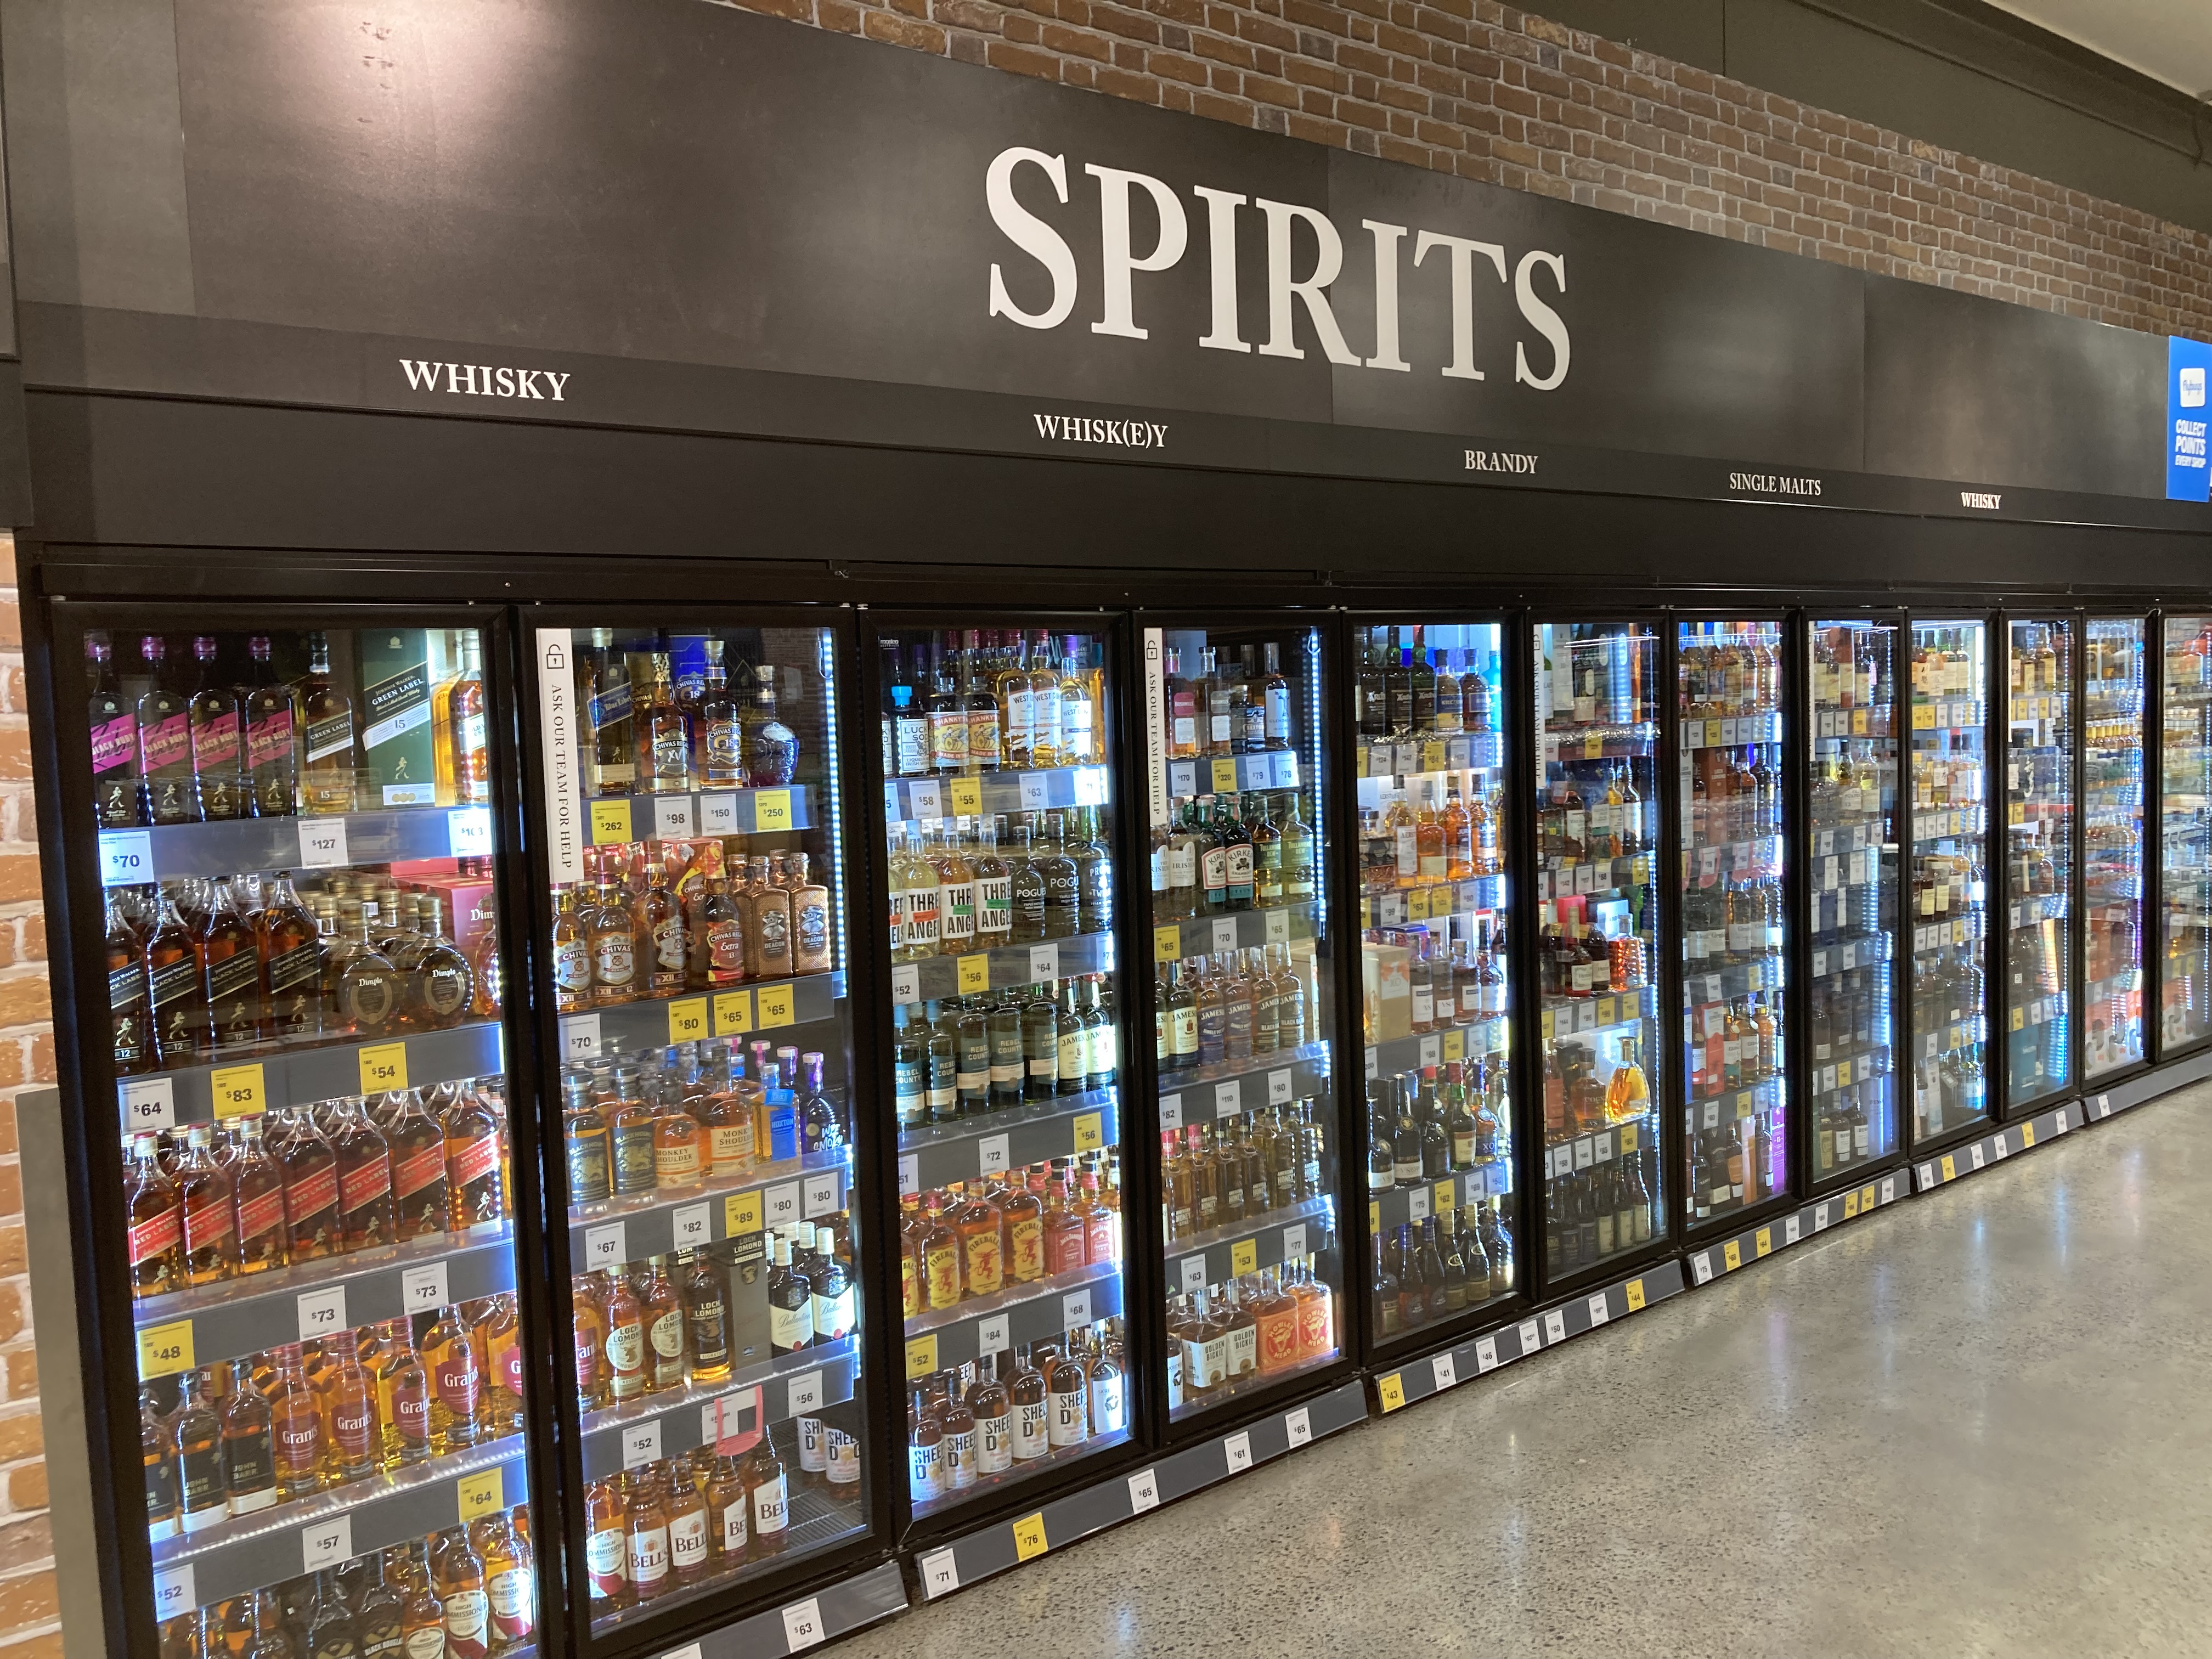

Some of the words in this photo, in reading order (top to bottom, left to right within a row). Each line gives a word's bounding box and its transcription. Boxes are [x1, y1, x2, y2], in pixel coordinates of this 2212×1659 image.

[985, 145, 1572, 391] SPIRITS
[400, 359, 570, 401] WHISKY
[1034, 414, 1168, 449] WHISK(E)Y
[2176, 419, 2207, 437] COLLECT
[2175, 436, 2206, 455] POINTS
[1464, 449, 1538, 474] BRANDY
[1729, 472, 1778, 493] SINGLE
[1780, 476, 1821, 496] MALTS
[1961, 492, 2001, 510] WHISKY
[375, 682, 395, 696] JOHNNIE
[676, 679, 696, 689] CHIVAS
[372, 689, 398, 706] GREEN
[399, 679, 424, 694] LABEL
[552, 685, 563, 712] ASK
[605, 700, 617, 709] Blue
[618, 695, 631, 706] Label
[1013, 696, 1028, 704] WEST
[394, 719, 406, 729] 15
[310, 727, 331, 741] GREEN
[332, 721, 351, 732] LABEL
[554, 716, 565, 746] OUR
[710, 728, 731, 738] CHIVAS
[92, 741, 112, 755] BLACK
[250, 737, 271, 750] BLACK
[654, 741, 676, 749] CHIVAS
[668, 750, 681, 761] XV
[556, 751, 567, 794] TEAM
[1028, 788, 1041, 797] $63
[919, 796, 934, 805] $58
[960, 795, 974, 805] $55
[558, 798, 569, 825] FOR
[712, 809, 729, 817] $150
[667, 814, 685, 823] $98
[601, 822, 622, 831] $262
[312, 839, 336, 849] $127
[561, 830, 572, 868] HELP
[112, 854, 140, 868] $70
[982, 882, 1011, 900] THREE
[1017, 888, 1046, 897] POGUES
[909, 891, 939, 907] THREE
[710, 933, 729, 941] CHIVAS
[601, 945, 631, 955] CHIVAS
[721, 942, 738, 950] Extra
[764, 940, 785, 949] DEACON
[274, 964, 295, 975] BLACK
[295, 952, 317, 966] LABEL
[1037, 963, 1050, 972] $64
[212, 973, 234, 983] BLACK
[235, 960, 256, 972] LABEL
[432, 968, 456, 978] Dimple
[966, 972, 981, 982] $56
[359, 977, 382, 987] Dimple
[662, 973, 674, 983] XII
[895, 986, 910, 995] $52
[562, 993, 574, 1002] XII
[768, 1005, 785, 1015] $65
[724, 1011, 742, 1022] $65
[679, 1018, 698, 1029] $80
[173, 1042, 183, 1051] 12
[571, 1037, 591, 1048] $70
[371, 1065, 395, 1079] $54
[896, 1075, 921, 1084] COUNTY
[226, 1088, 252, 1102] $83
[133, 1102, 161, 1116] $64
[771, 1118, 793, 1128] HOXTON
[1082, 1131, 1095, 1139] $56
[813, 1134, 843, 1151] SMOKY
[657, 1147, 688, 1156] MONKEY
[988, 1152, 1000, 1160] $72
[656, 1154, 693, 1163] SHOULDER
[346, 1183, 362, 1194] RED
[363, 1167, 388, 1184] LABEL
[292, 1195, 307, 1206] RED
[309, 1178, 336, 1195] LABEL
[813, 1190, 831, 1201] $80
[774, 1200, 791, 1211] $80
[735, 1211, 753, 1223] $89
[684, 1221, 702, 1232] $82
[597, 1240, 616, 1252] $67
[969, 1235, 1000, 1251] FIREBALL
[416, 1286, 437, 1298] $73
[1631, 1293, 1640, 1301] $44
[701, 1300, 720, 1310] LOCH
[1070, 1305, 1083, 1314] $68
[312, 1309, 335, 1323] $73
[695, 1306, 725, 1316] LOMOND
[620, 1325, 638, 1335] LOCH
[1268, 1321, 1294, 1338] HOWLER
[1551, 1325, 1560, 1333] $50
[613, 1331, 642, 1342] LOMOND
[986, 1330, 1000, 1340] $84
[1234, 1329, 1255, 1342] GOLDEN
[1235, 1338, 1254, 1349] BICKIE
[153, 1346, 180, 1359] $48
[700, 1350, 726, 1359] SIGNATURE
[1274, 1348, 1291, 1358] HEAD
[1482, 1352, 1492, 1361] $46
[913, 1356, 929, 1365] $52
[1440, 1369, 1450, 1378] $41
[797, 1392, 812, 1403] $56
[1386, 1391, 1398, 1400] $43
[337, 1414, 372, 1430] Grant's
[1294, 1425, 1306, 1434] $65
[283, 1427, 319, 1444] Grant's
[633, 1438, 652, 1449] $52
[1234, 1449, 1245, 1458] $61
[233, 1462, 257, 1472] JOHN
[233, 1470, 257, 1479] BARR
[1139, 1488, 1152, 1497] $65
[470, 1491, 492, 1506] $64
[317, 1536, 340, 1549] $57
[1024, 1536, 1038, 1546] $76
[936, 1572, 949, 1582] $71
[157, 1586, 182, 1600] $52
[794, 1623, 812, 1634] $63
